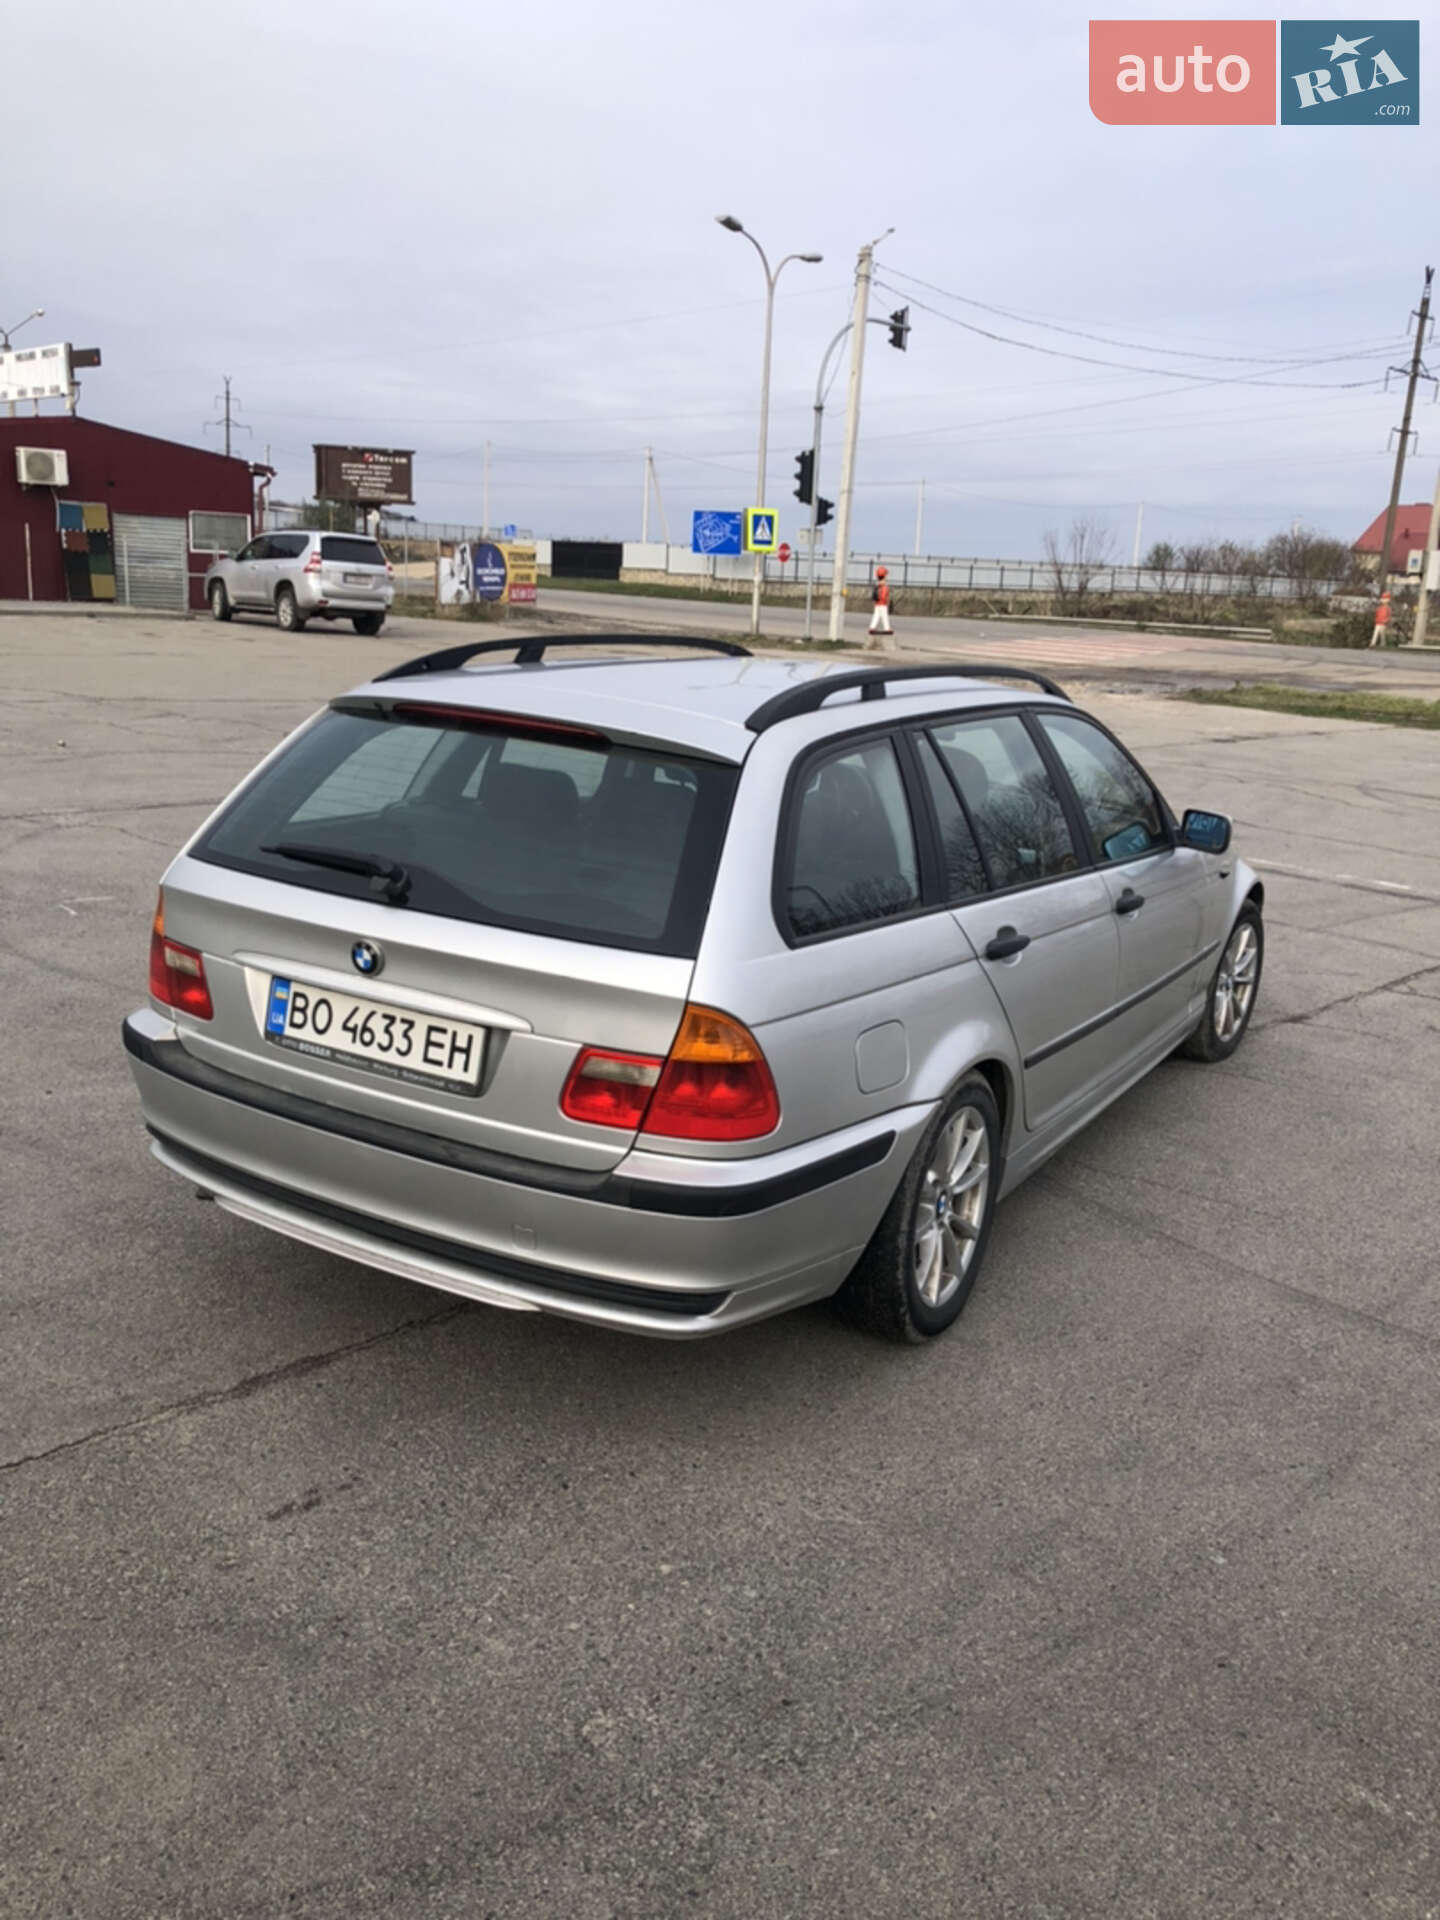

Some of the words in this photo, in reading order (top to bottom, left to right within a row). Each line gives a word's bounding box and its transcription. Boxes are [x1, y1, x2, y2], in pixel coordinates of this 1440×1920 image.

[271, 1012, 285, 1024] UA
[289, 991, 333, 1035] BO
[342, 1006, 416, 1057] 4633
[422, 1025, 474, 1073] EH
